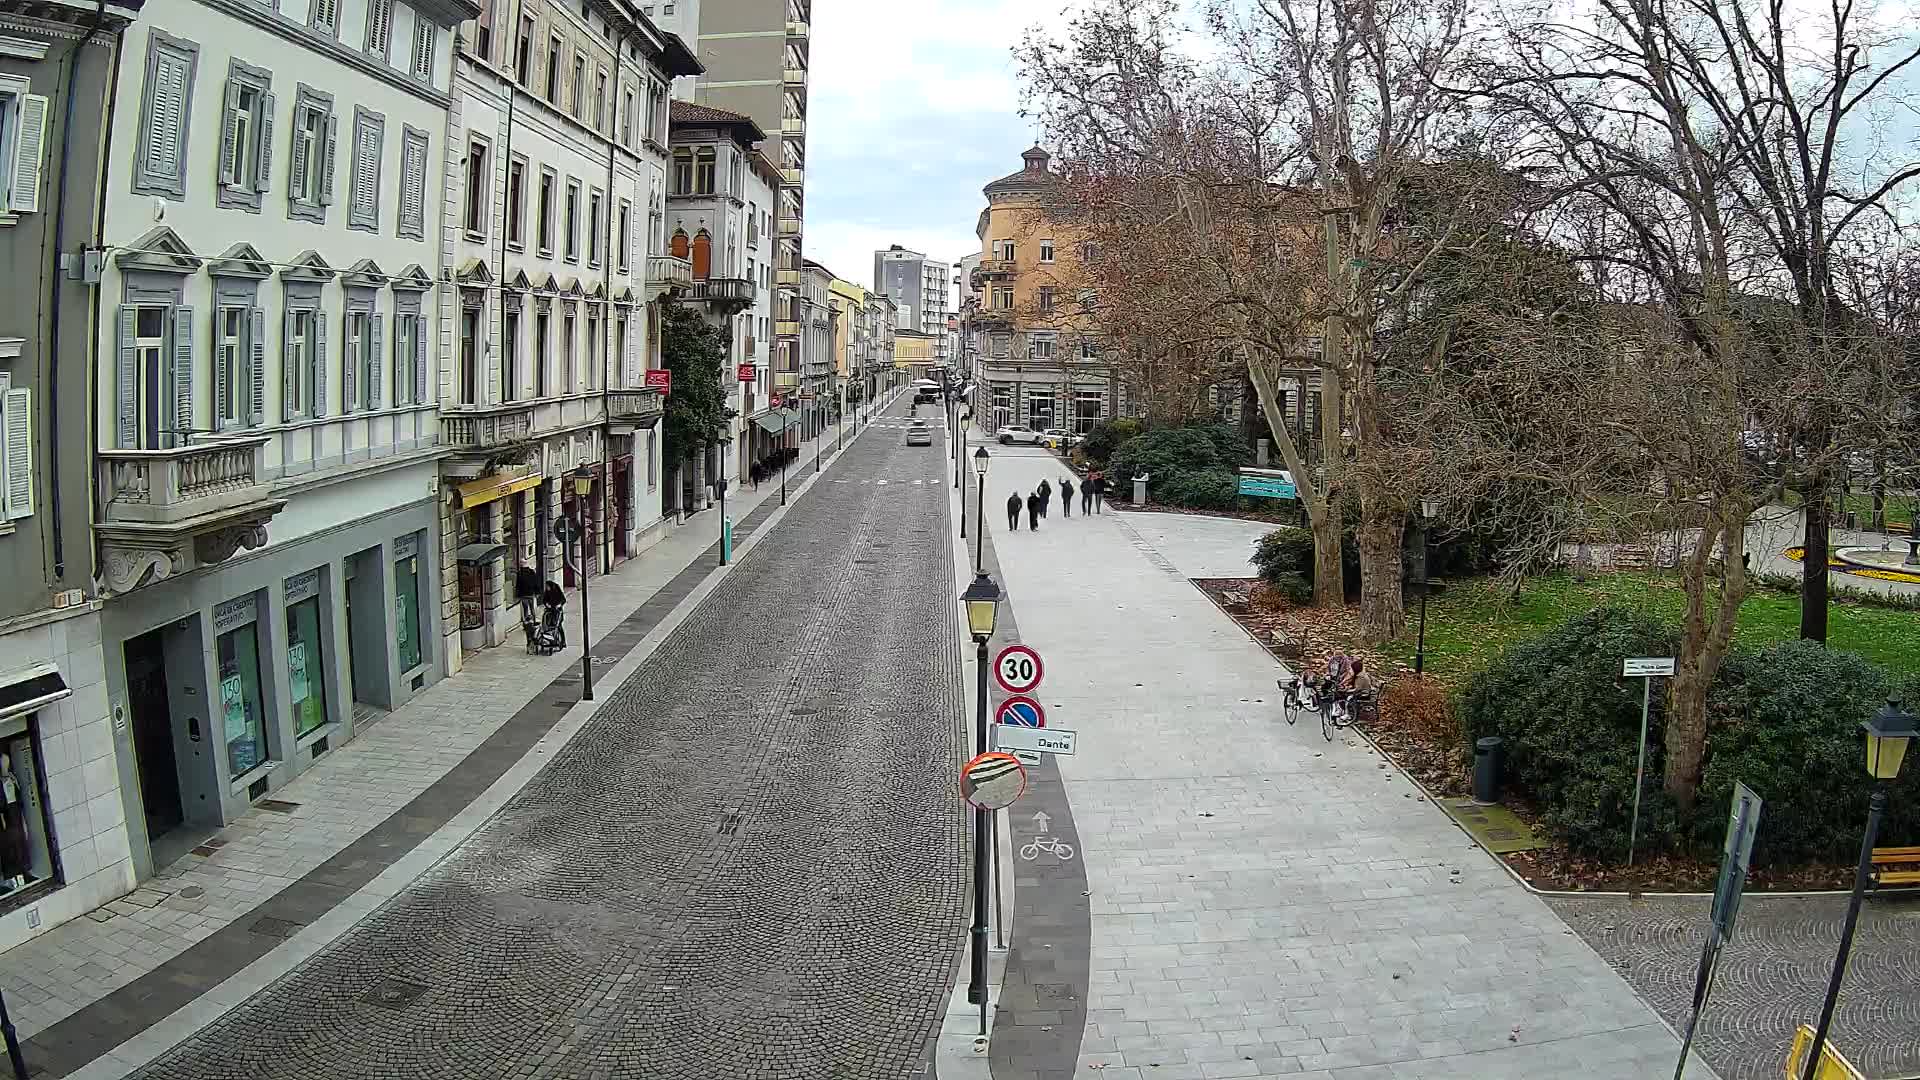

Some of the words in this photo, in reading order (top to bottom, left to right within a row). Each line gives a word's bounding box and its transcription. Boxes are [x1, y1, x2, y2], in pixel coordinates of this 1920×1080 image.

[289, 646, 304, 666] 130
[1005, 658, 1033, 681] 30
[222, 678, 240, 700] 130
[1038, 738, 1069, 749] Dante
